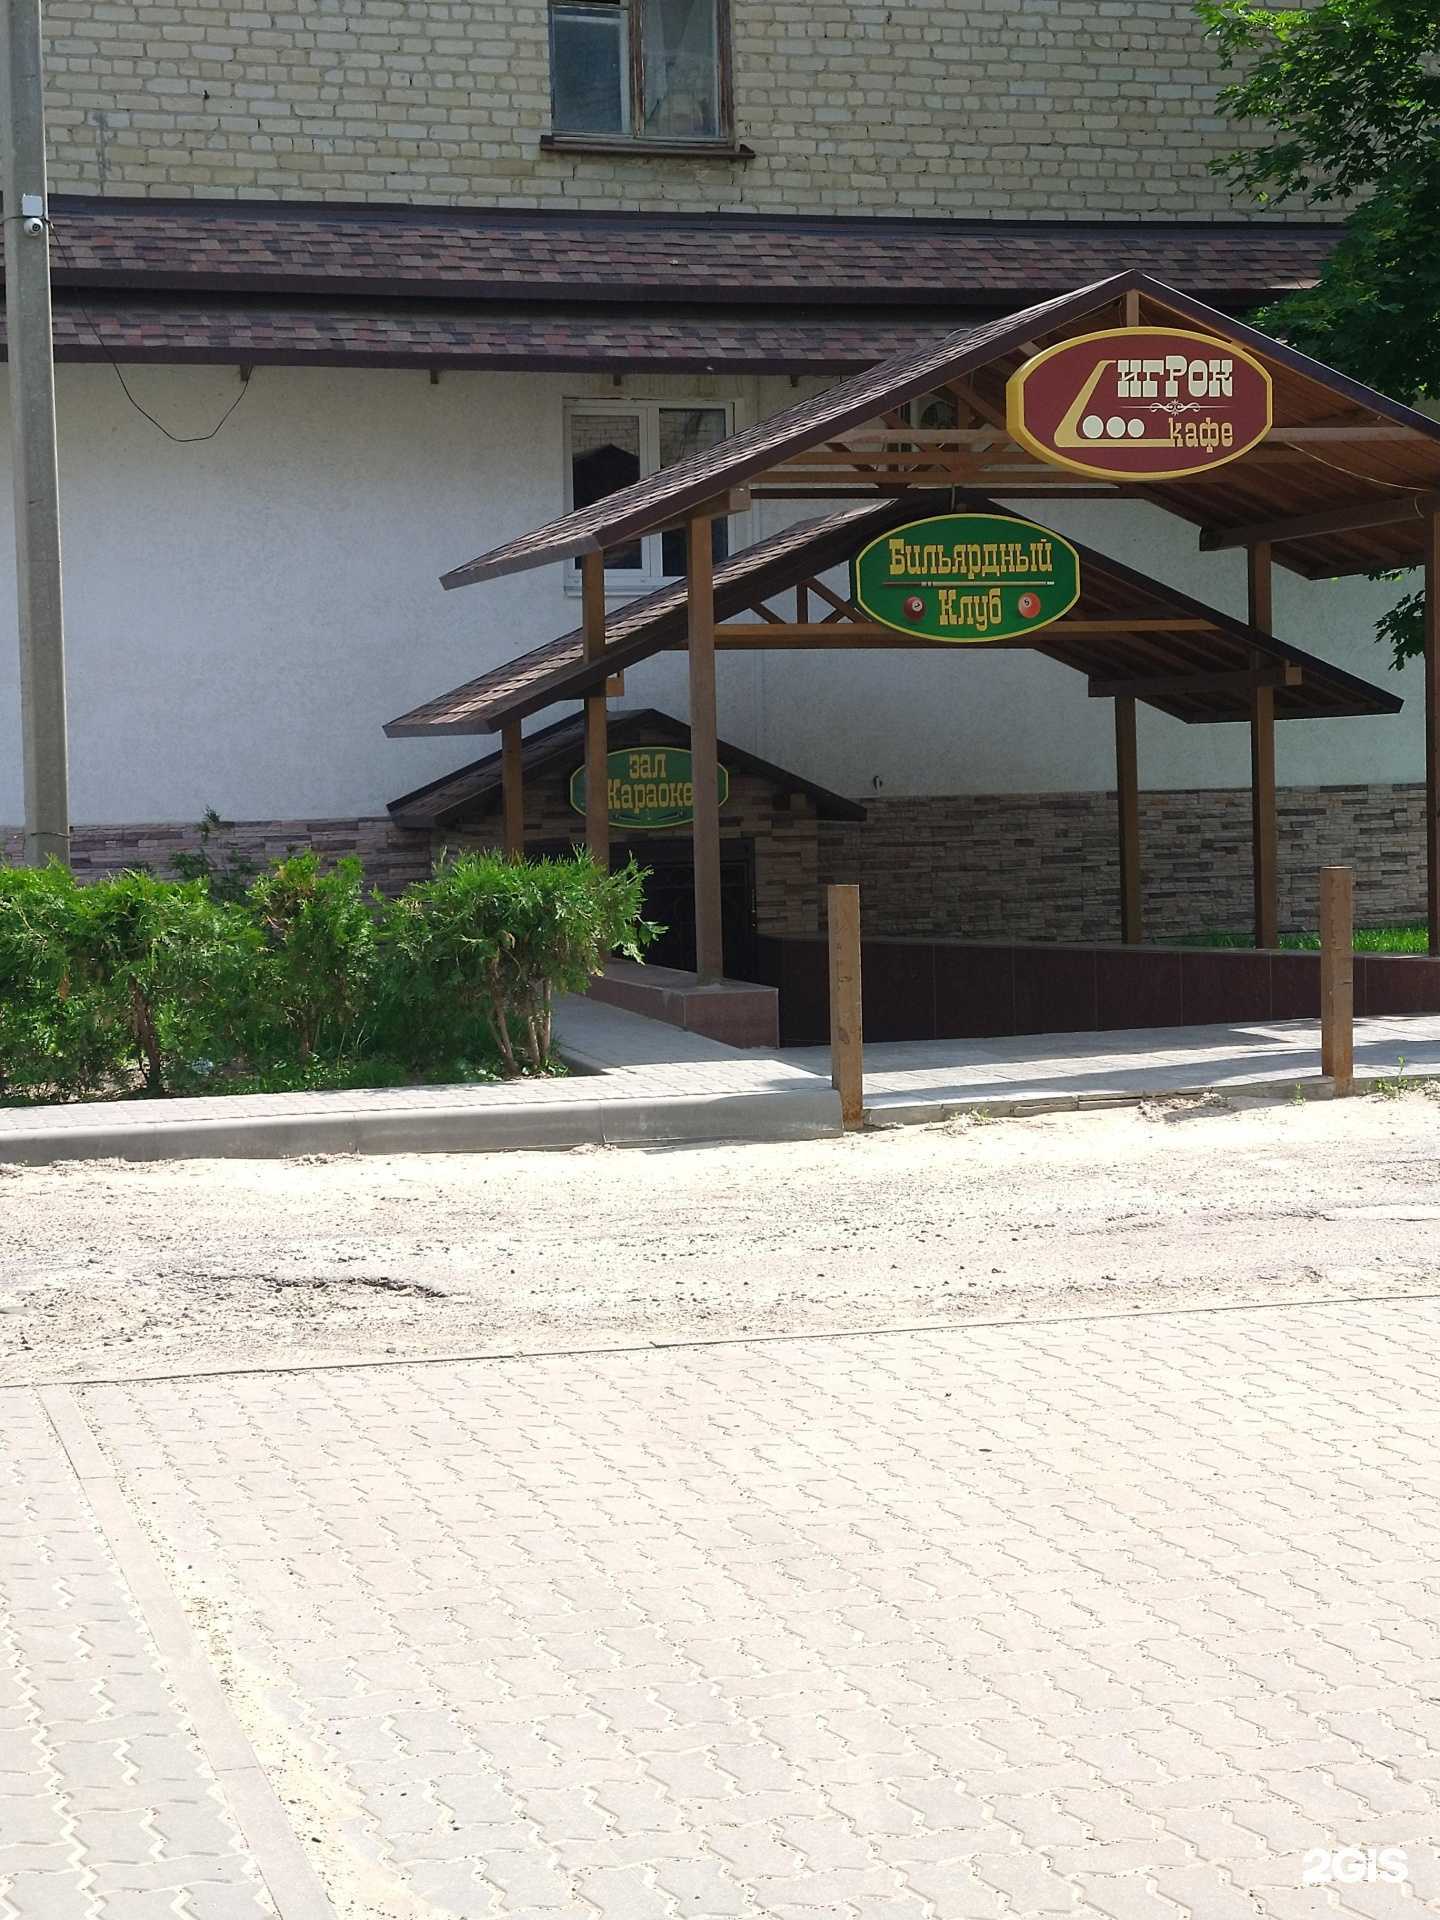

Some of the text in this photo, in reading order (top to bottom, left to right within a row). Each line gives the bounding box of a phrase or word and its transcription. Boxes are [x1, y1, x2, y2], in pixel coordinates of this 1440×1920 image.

[1117, 355, 1233, 398] ИГРОК
[1168, 417, 1233, 453] кафе
[889, 538, 1053, 579] Бильярдный
[938, 587, 1002, 632] Клуб
[629, 753, 667, 779] зал
[607, 778, 695, 814] Караоке
